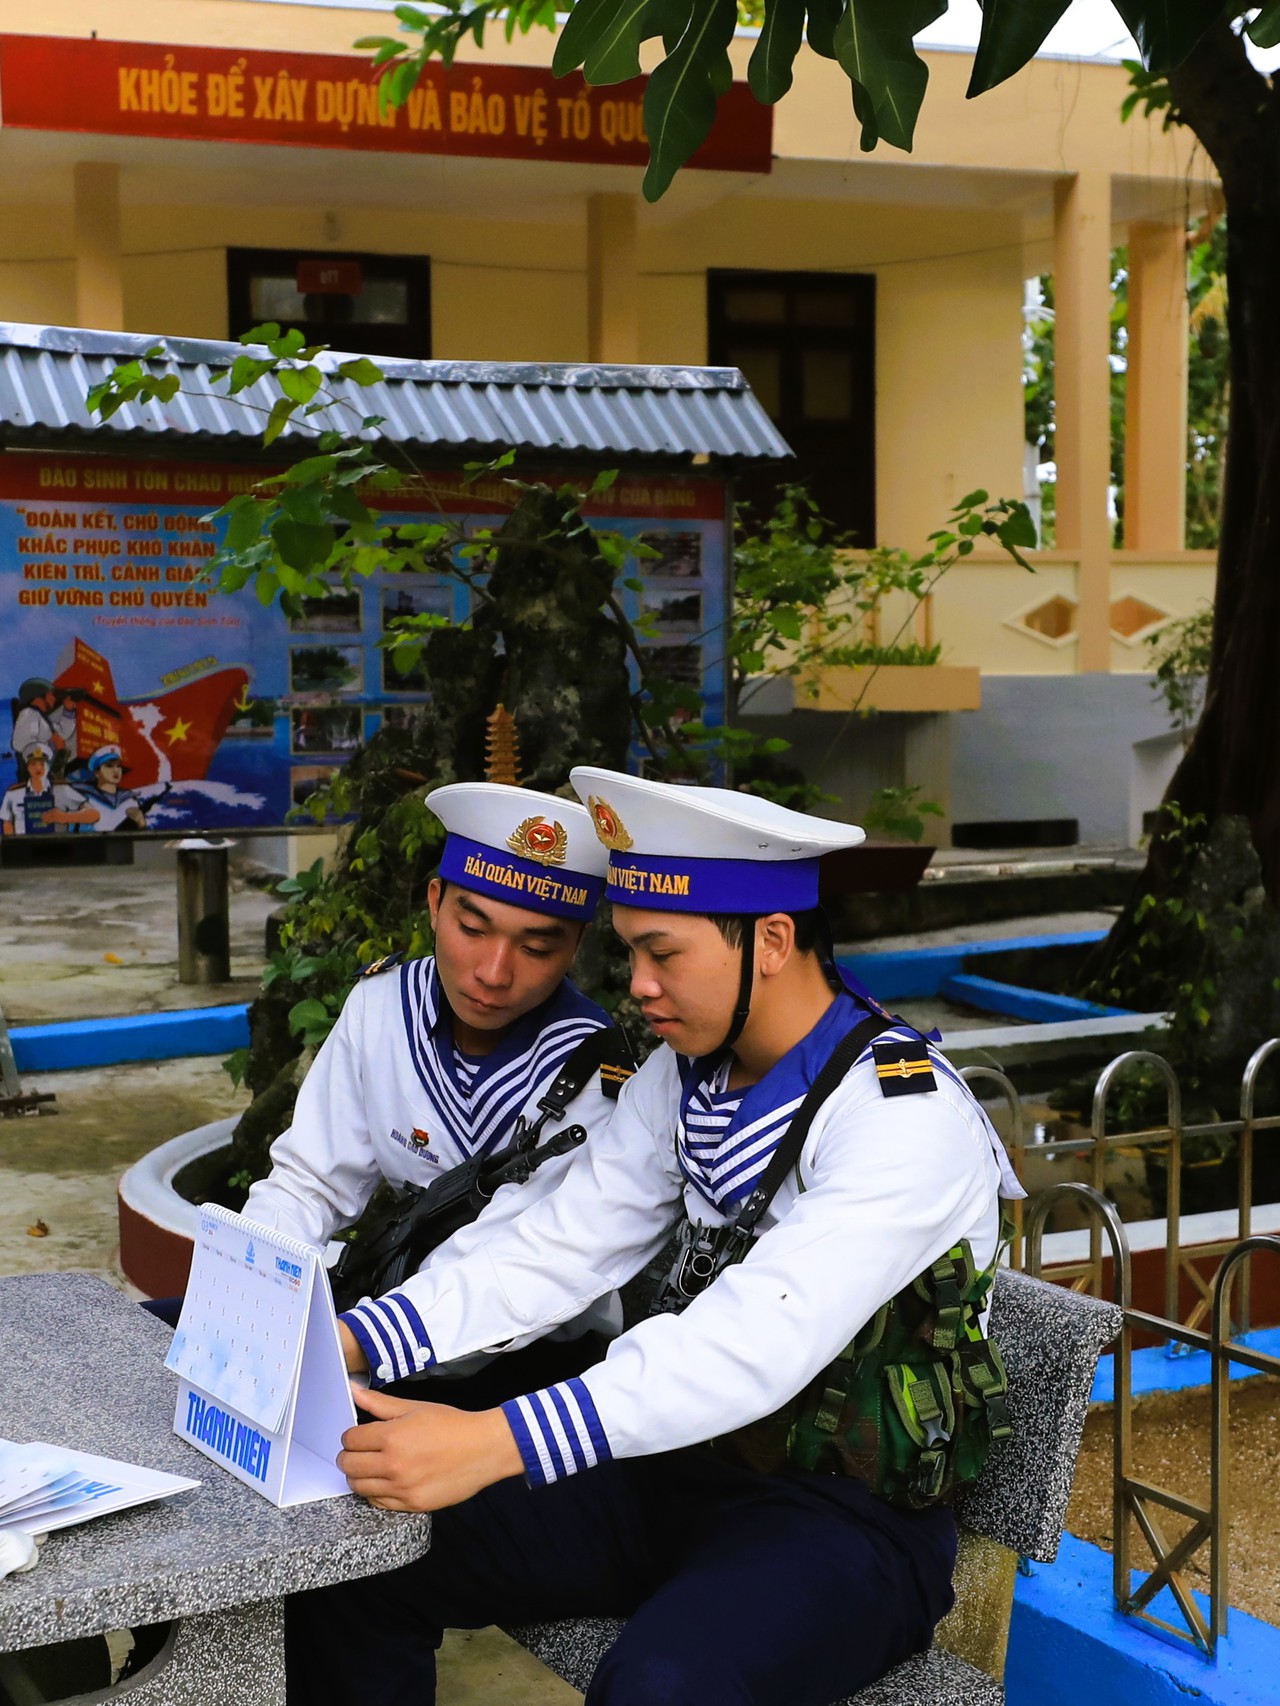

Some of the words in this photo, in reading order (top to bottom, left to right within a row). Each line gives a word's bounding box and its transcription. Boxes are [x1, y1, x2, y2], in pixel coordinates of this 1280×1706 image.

[118, 54, 199, 115] KHỎE
[207, 57, 247, 118] ĐỂ
[253, 69, 308, 122] XÂY
[408, 79, 442, 131] VÀ
[450, 76, 506, 135] BẢO
[514, 87, 548, 146] VỆ
[558, 84, 591, 140] TỔ
[600, 94, 648, 146] QU
[84, 468, 128, 489] SINH
[123, 511, 159, 531] CHỦ
[19, 532, 67, 554] KHẮC
[73, 539, 121, 558] PHỤC
[24, 561, 67, 580] KIÊN
[19, 587, 51, 605] GIỮ
[55, 587, 104, 606] VỮNG
[110, 586, 144, 607] CHỦ
[464, 852, 487, 878] HẢI
[485, 864, 526, 891] QUÂN
[527, 875, 562, 901] VIỆT
[560, 885, 588, 906] NAM
[618, 865, 648, 894] VIỆT
[649, 872, 690, 895] NAM
[186, 1391, 236, 1459] THANH
[232, 1421, 271, 1483] NIÊN
